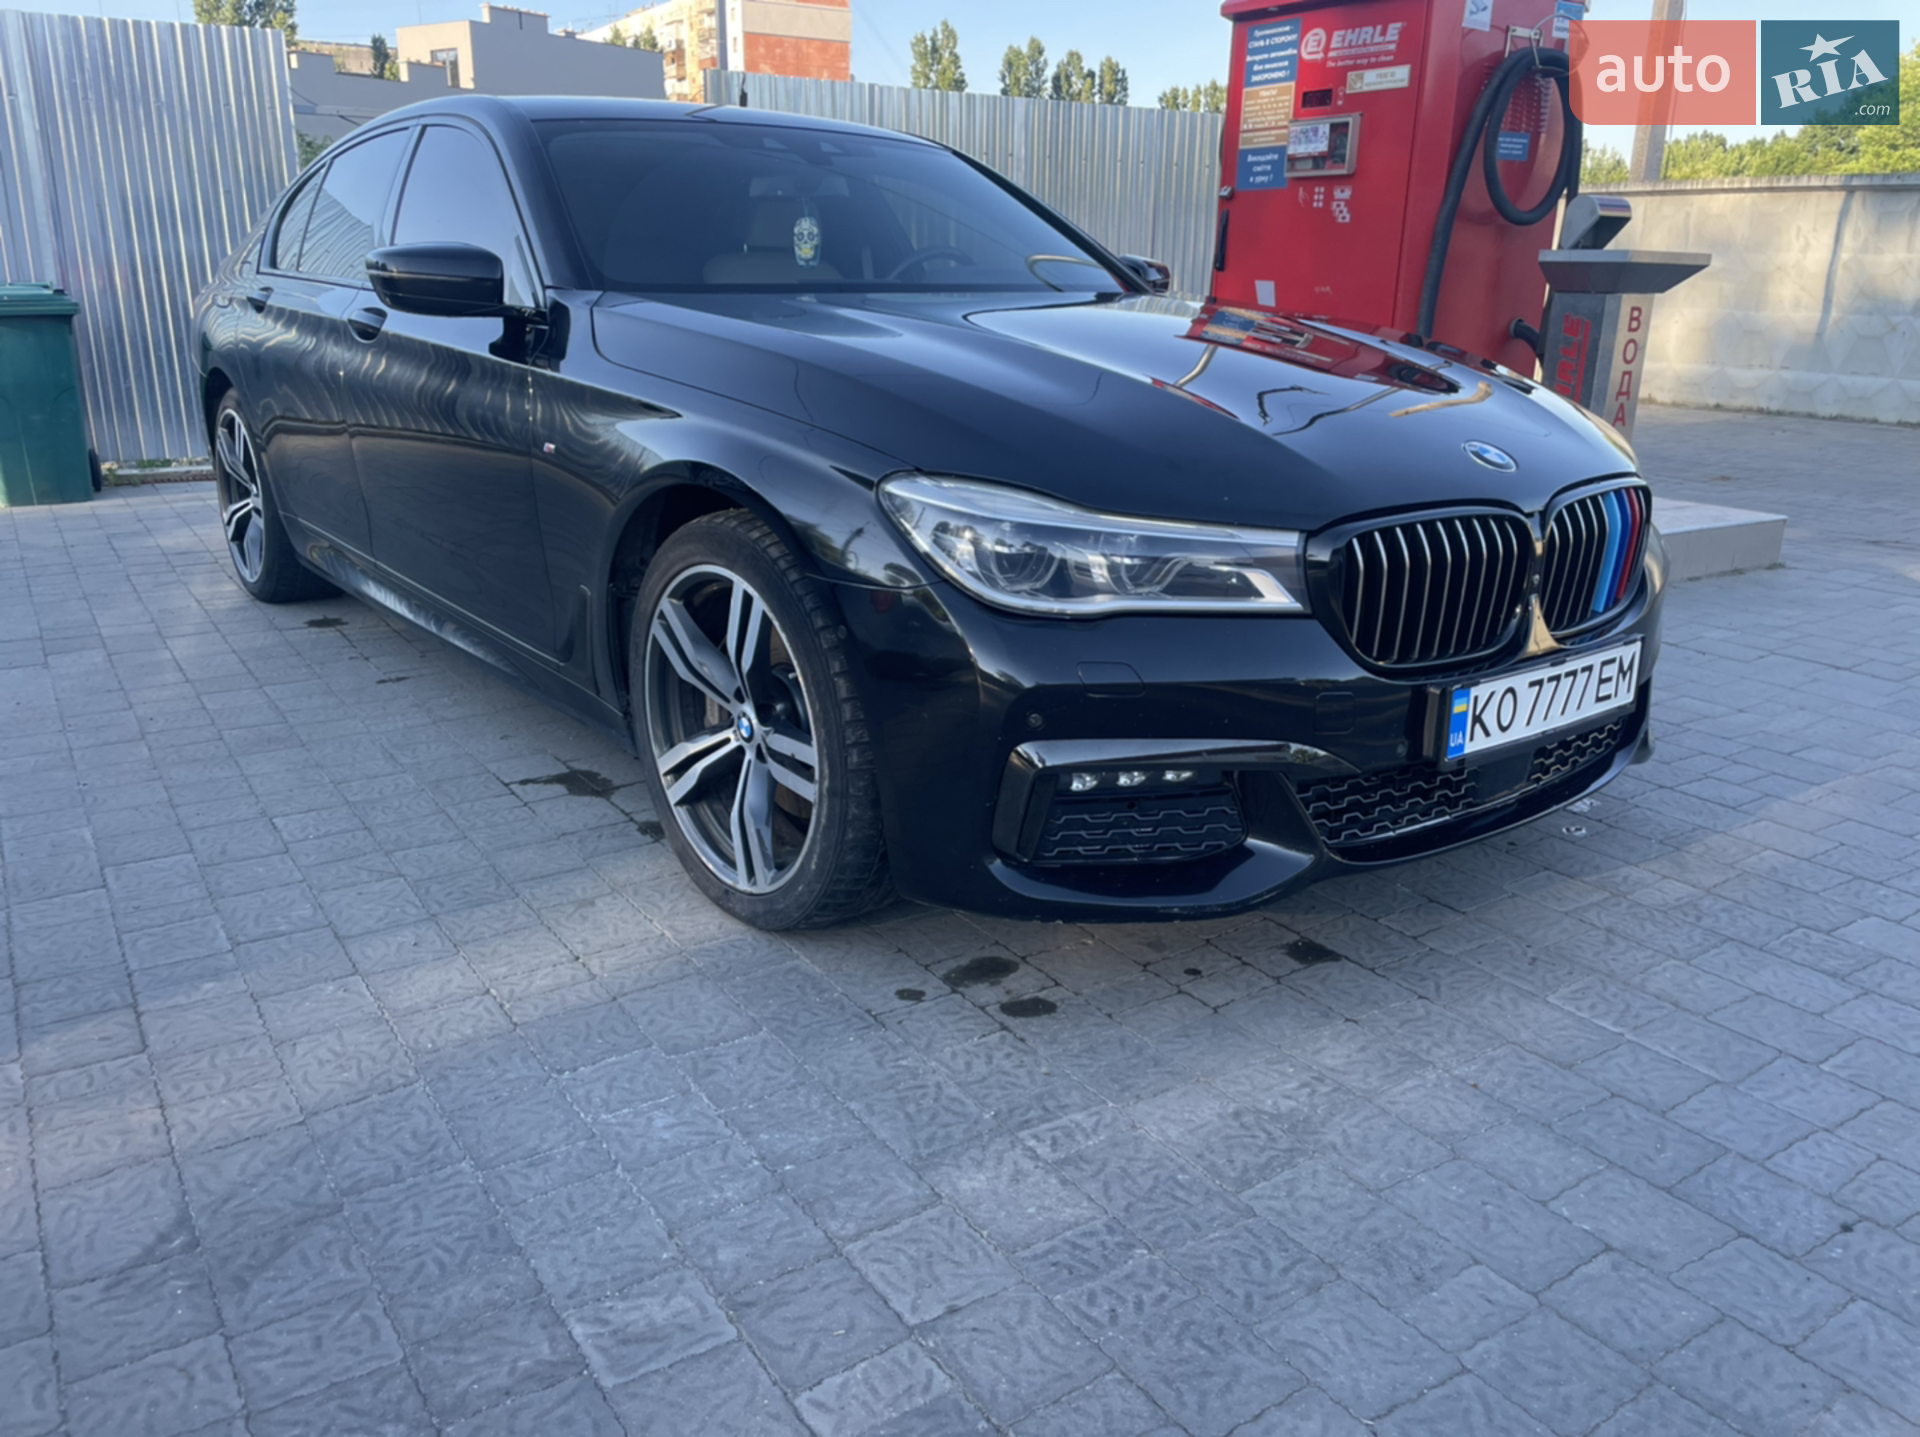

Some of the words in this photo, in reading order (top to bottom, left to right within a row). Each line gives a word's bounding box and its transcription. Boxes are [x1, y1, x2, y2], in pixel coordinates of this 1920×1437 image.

[1330, 22, 1402, 48] EHRLE
[1337, 59, 1355, 67] better
[1356, 57, 1369, 66] way
[1378, 53, 1394, 62] clean
[1612, 306, 1642, 428] ВОДА
[1469, 685, 1518, 743] KO
[1525, 664, 1595, 727] 7777
[1595, 651, 1636, 704] EM
[1450, 730, 1464, 747] UA
